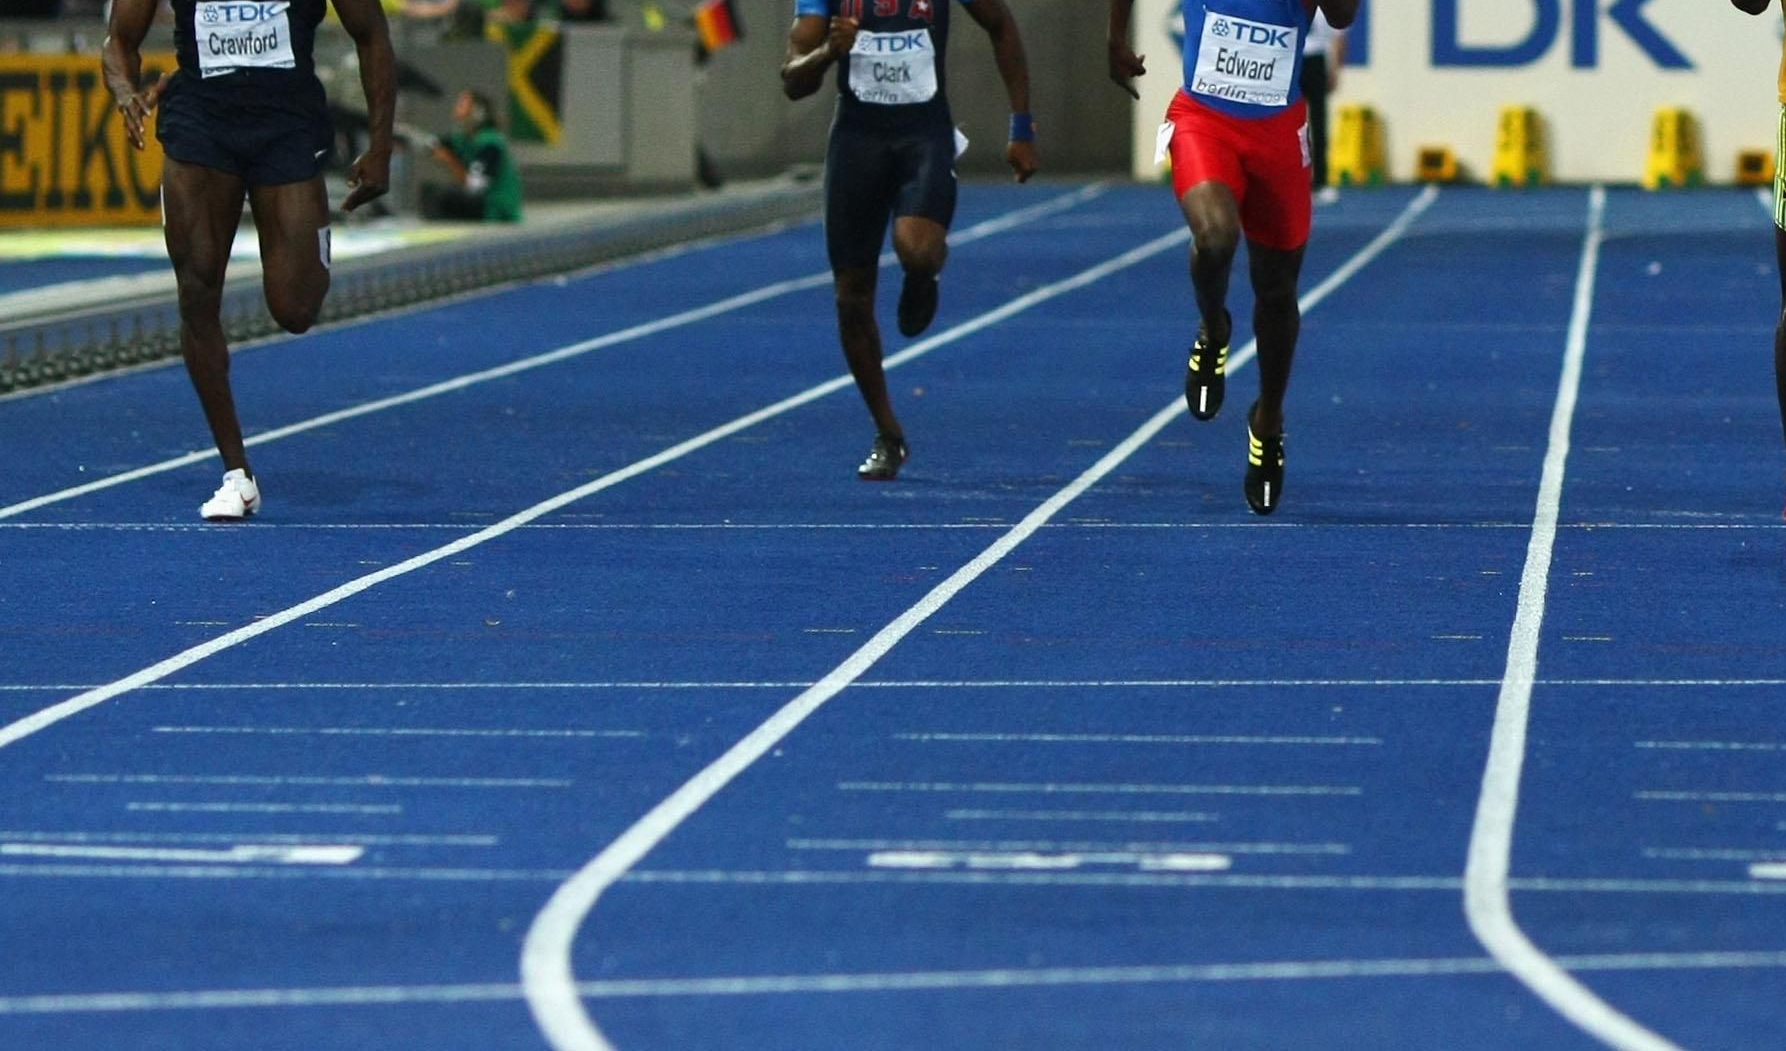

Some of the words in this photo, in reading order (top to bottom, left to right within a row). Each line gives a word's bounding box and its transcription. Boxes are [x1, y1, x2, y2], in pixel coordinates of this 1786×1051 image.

[218, 4, 279, 22] TDK
[208, 28, 278, 56] Crawford
[872, 33, 925, 52] TDK
[1232, 22, 1291, 48] TDK
[873, 62, 911, 83] Clark
[1215, 48, 1275, 81] Edward
[1196, 78, 1246, 99] berlin
